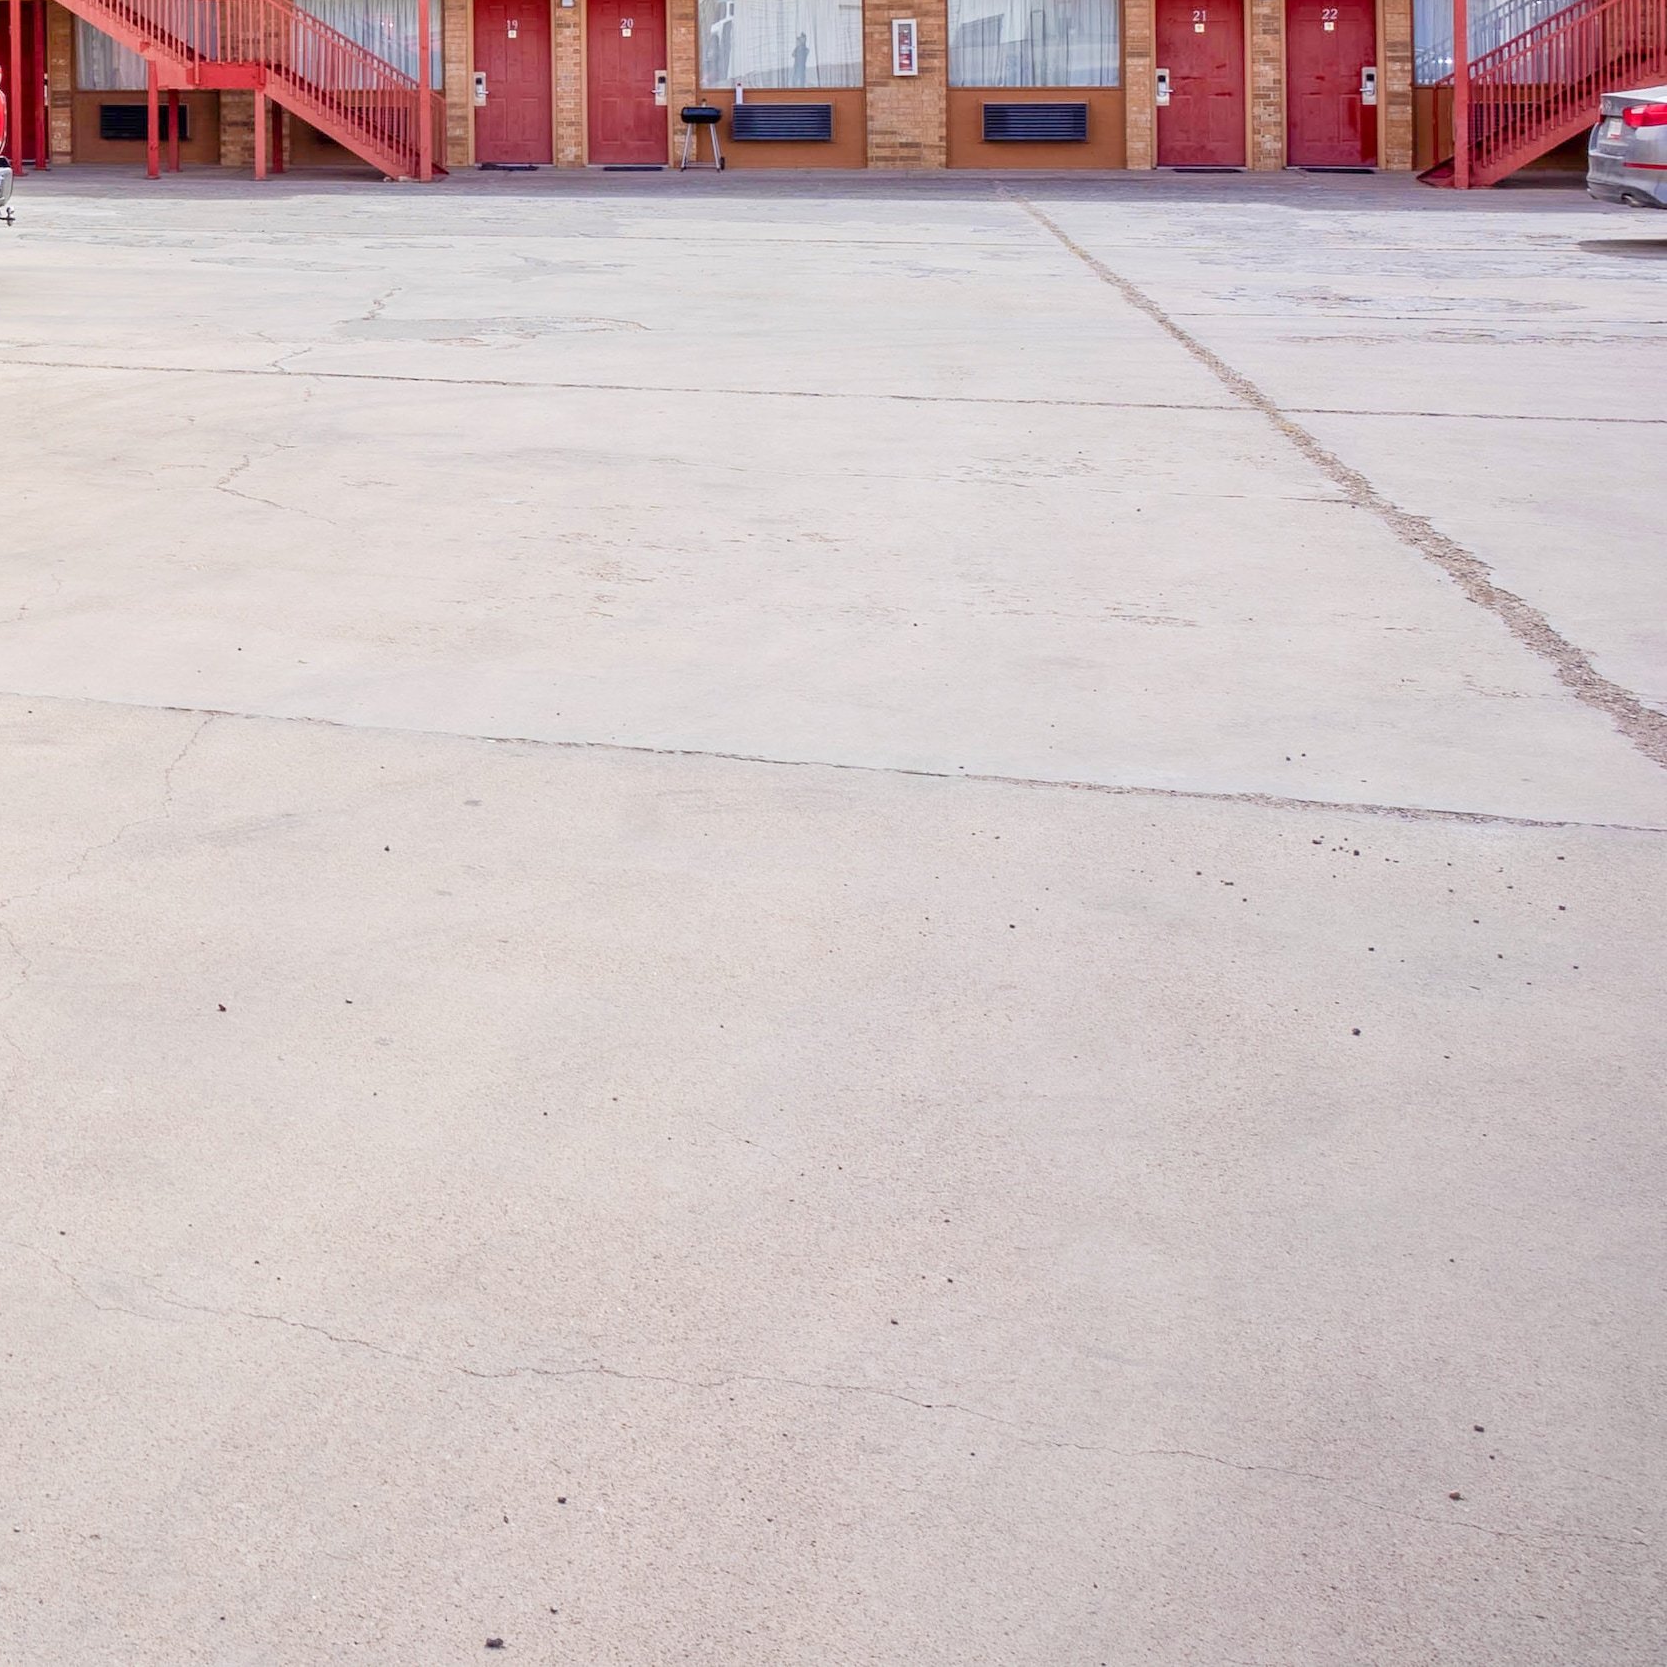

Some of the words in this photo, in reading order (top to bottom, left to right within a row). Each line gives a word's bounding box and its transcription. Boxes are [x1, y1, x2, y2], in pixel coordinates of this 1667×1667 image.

[1192, 10, 1206, 22] 21
[1322, 8, 1338, 20] 22
[506, 19, 518, 30] 19
[620, 18, 634, 29] 20
